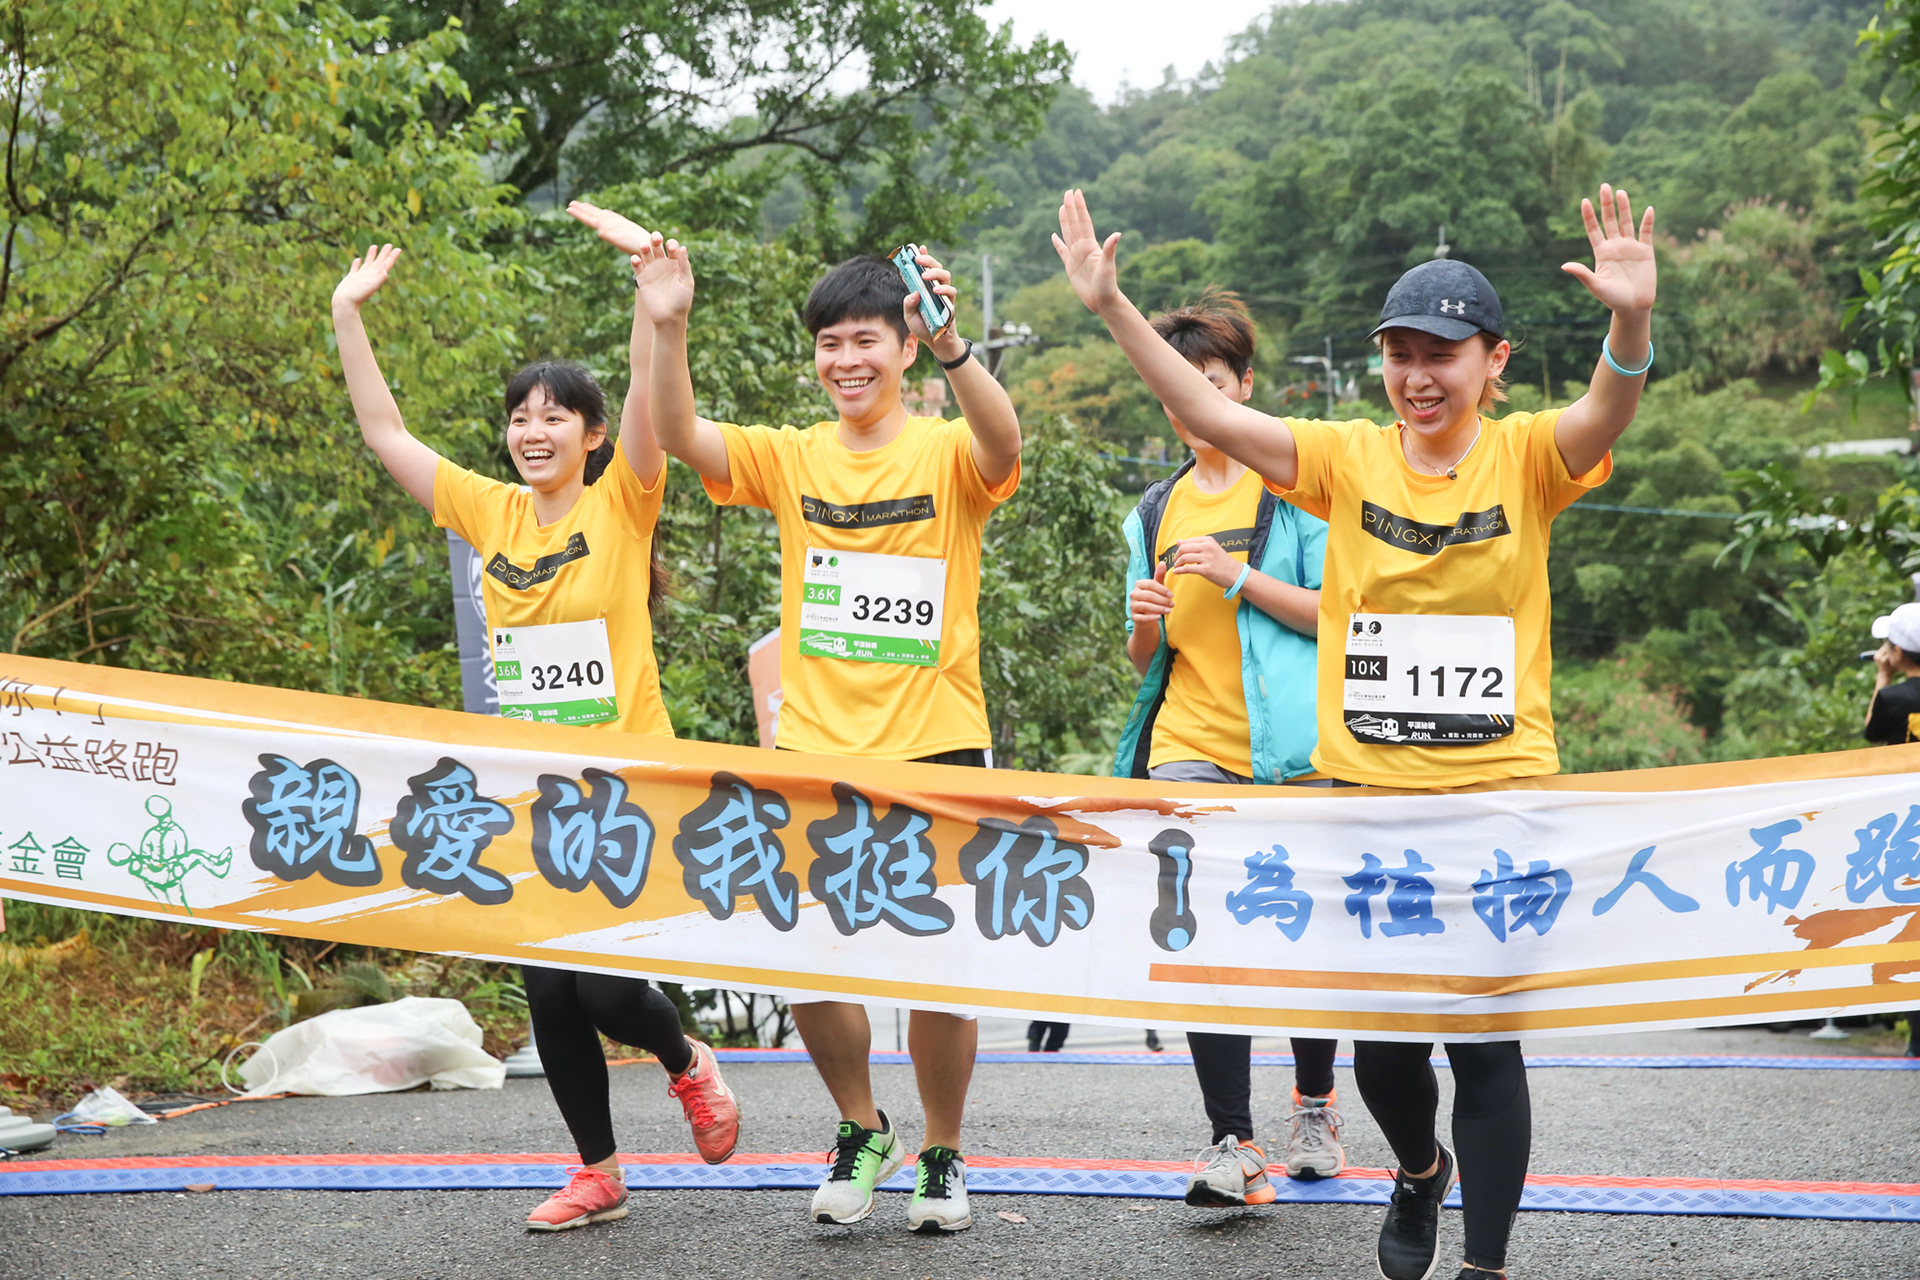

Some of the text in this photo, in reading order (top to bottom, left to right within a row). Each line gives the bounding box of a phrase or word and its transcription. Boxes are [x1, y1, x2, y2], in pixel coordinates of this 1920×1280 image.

[803, 502, 930, 524] PINGXI MARATHON
[1364, 510, 1442, 548] PINGXI
[808, 587, 836, 602] 3.6K
[852, 594, 934, 626] 3239
[855, 649, 874, 658] RUN
[498, 664, 519, 677] 3.6K
[531, 660, 604, 691] 3240
[1351, 660, 1381, 676] 10K
[1406, 665, 1504, 698] 1172
[1410, 732, 1432, 740] RUN
[0, 831, 91, 880] 金會
[1224, 803, 1920, 944] 為植物人而跑
